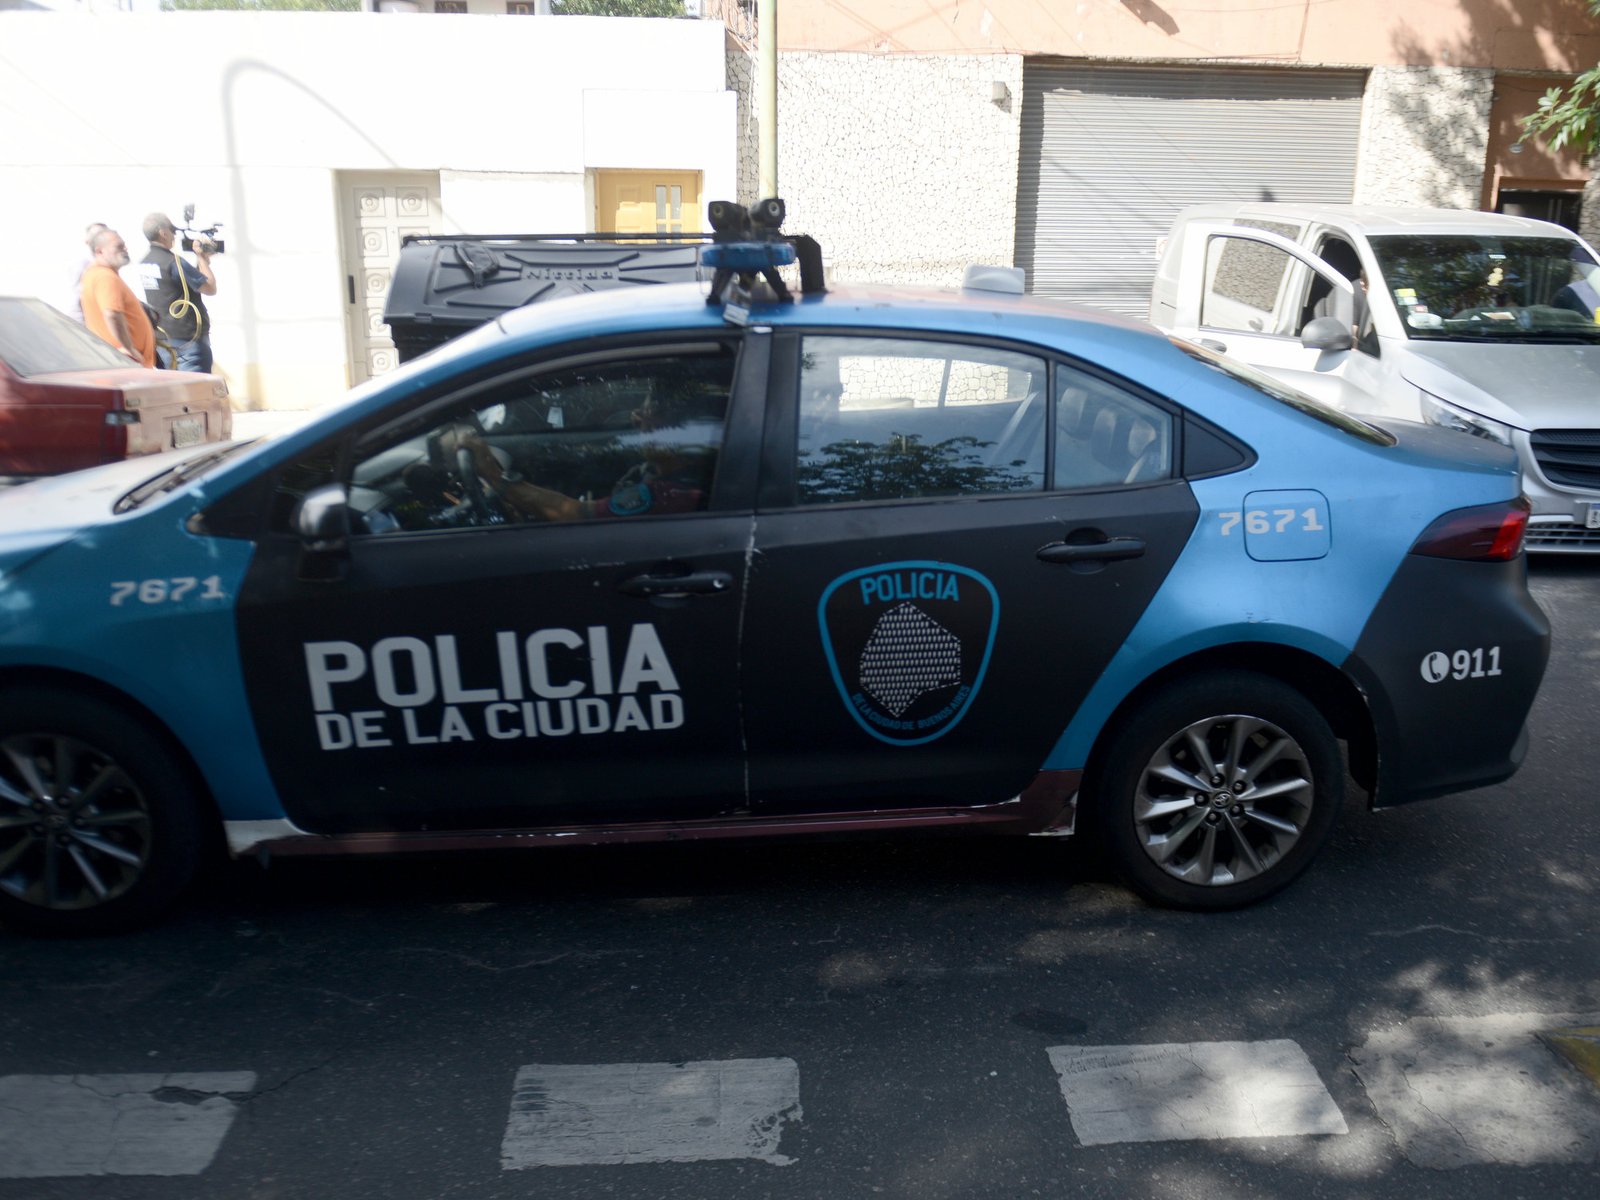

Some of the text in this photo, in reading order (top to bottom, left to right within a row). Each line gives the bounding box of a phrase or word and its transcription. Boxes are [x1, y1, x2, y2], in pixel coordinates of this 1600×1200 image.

[1219, 507, 1325, 538] 7671
[109, 575, 225, 607] 7671
[860, 572, 960, 605] POLICIA
[303, 622, 681, 712] POLICIA
[1451, 646, 1502, 681] 911
[316, 691, 687, 752] DE LA CIUDAD
[901, 720, 915, 730] DE
[917, 706, 954, 729] BUENOS
[950, 684, 971, 710] AIRES
